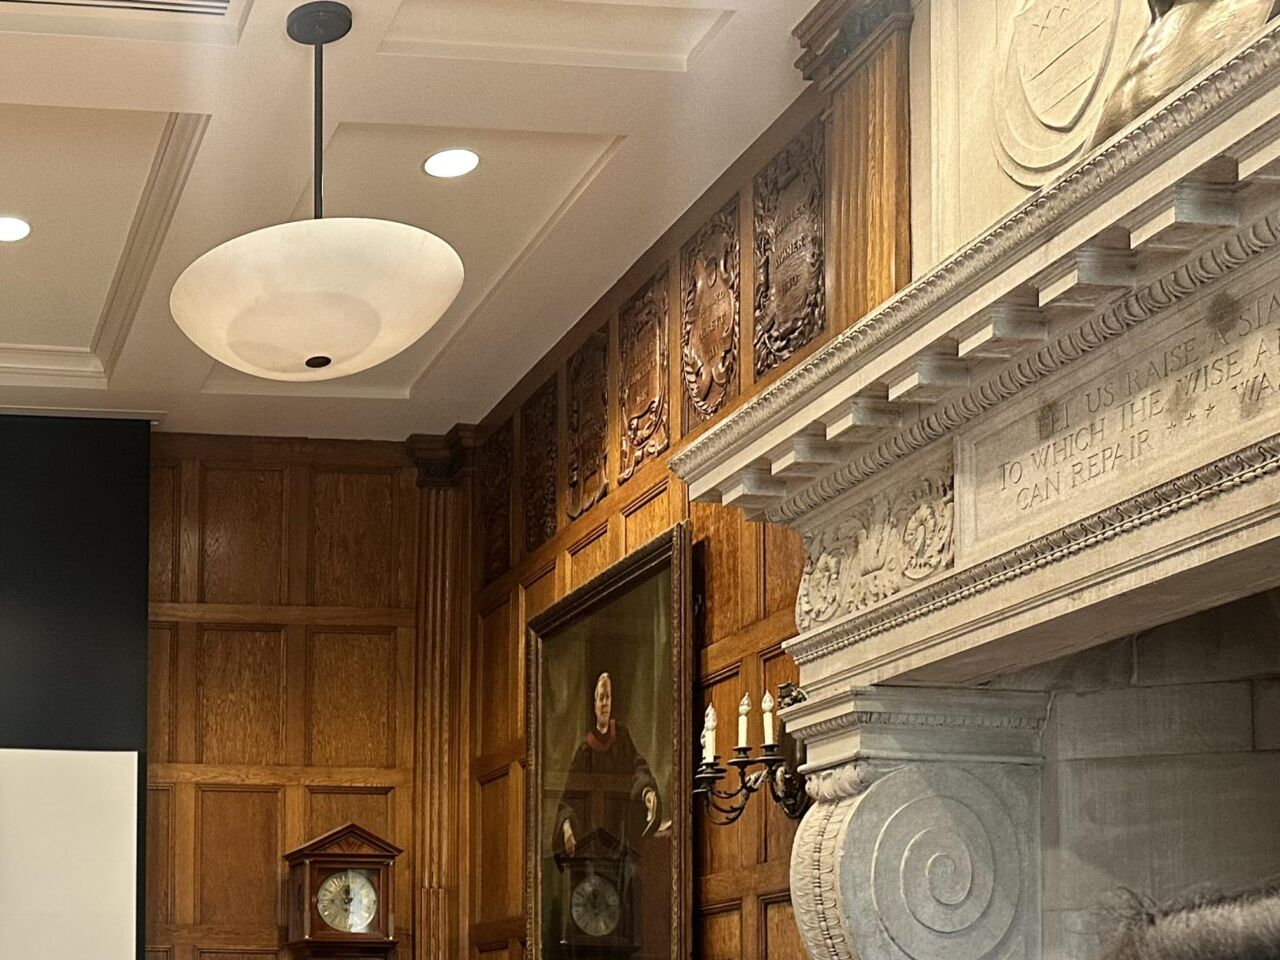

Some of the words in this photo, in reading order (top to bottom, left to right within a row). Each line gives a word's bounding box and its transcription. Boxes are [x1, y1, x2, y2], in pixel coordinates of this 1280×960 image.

[998, 460, 1023, 491] TO
[1030, 417, 1105, 469] WHICH
[1117, 389, 1164, 431] THE
[1176, 348, 1243, 396] WISE
[1037, 401, 1070, 438] LET
[1085, 384, 1114, 413] US
[1126, 337, 1199, 393] RAISE
[1210, 328, 1230, 354] A
[1016, 471, 1061, 511] CAN
[1071, 428, 1155, 489] REPAIR
